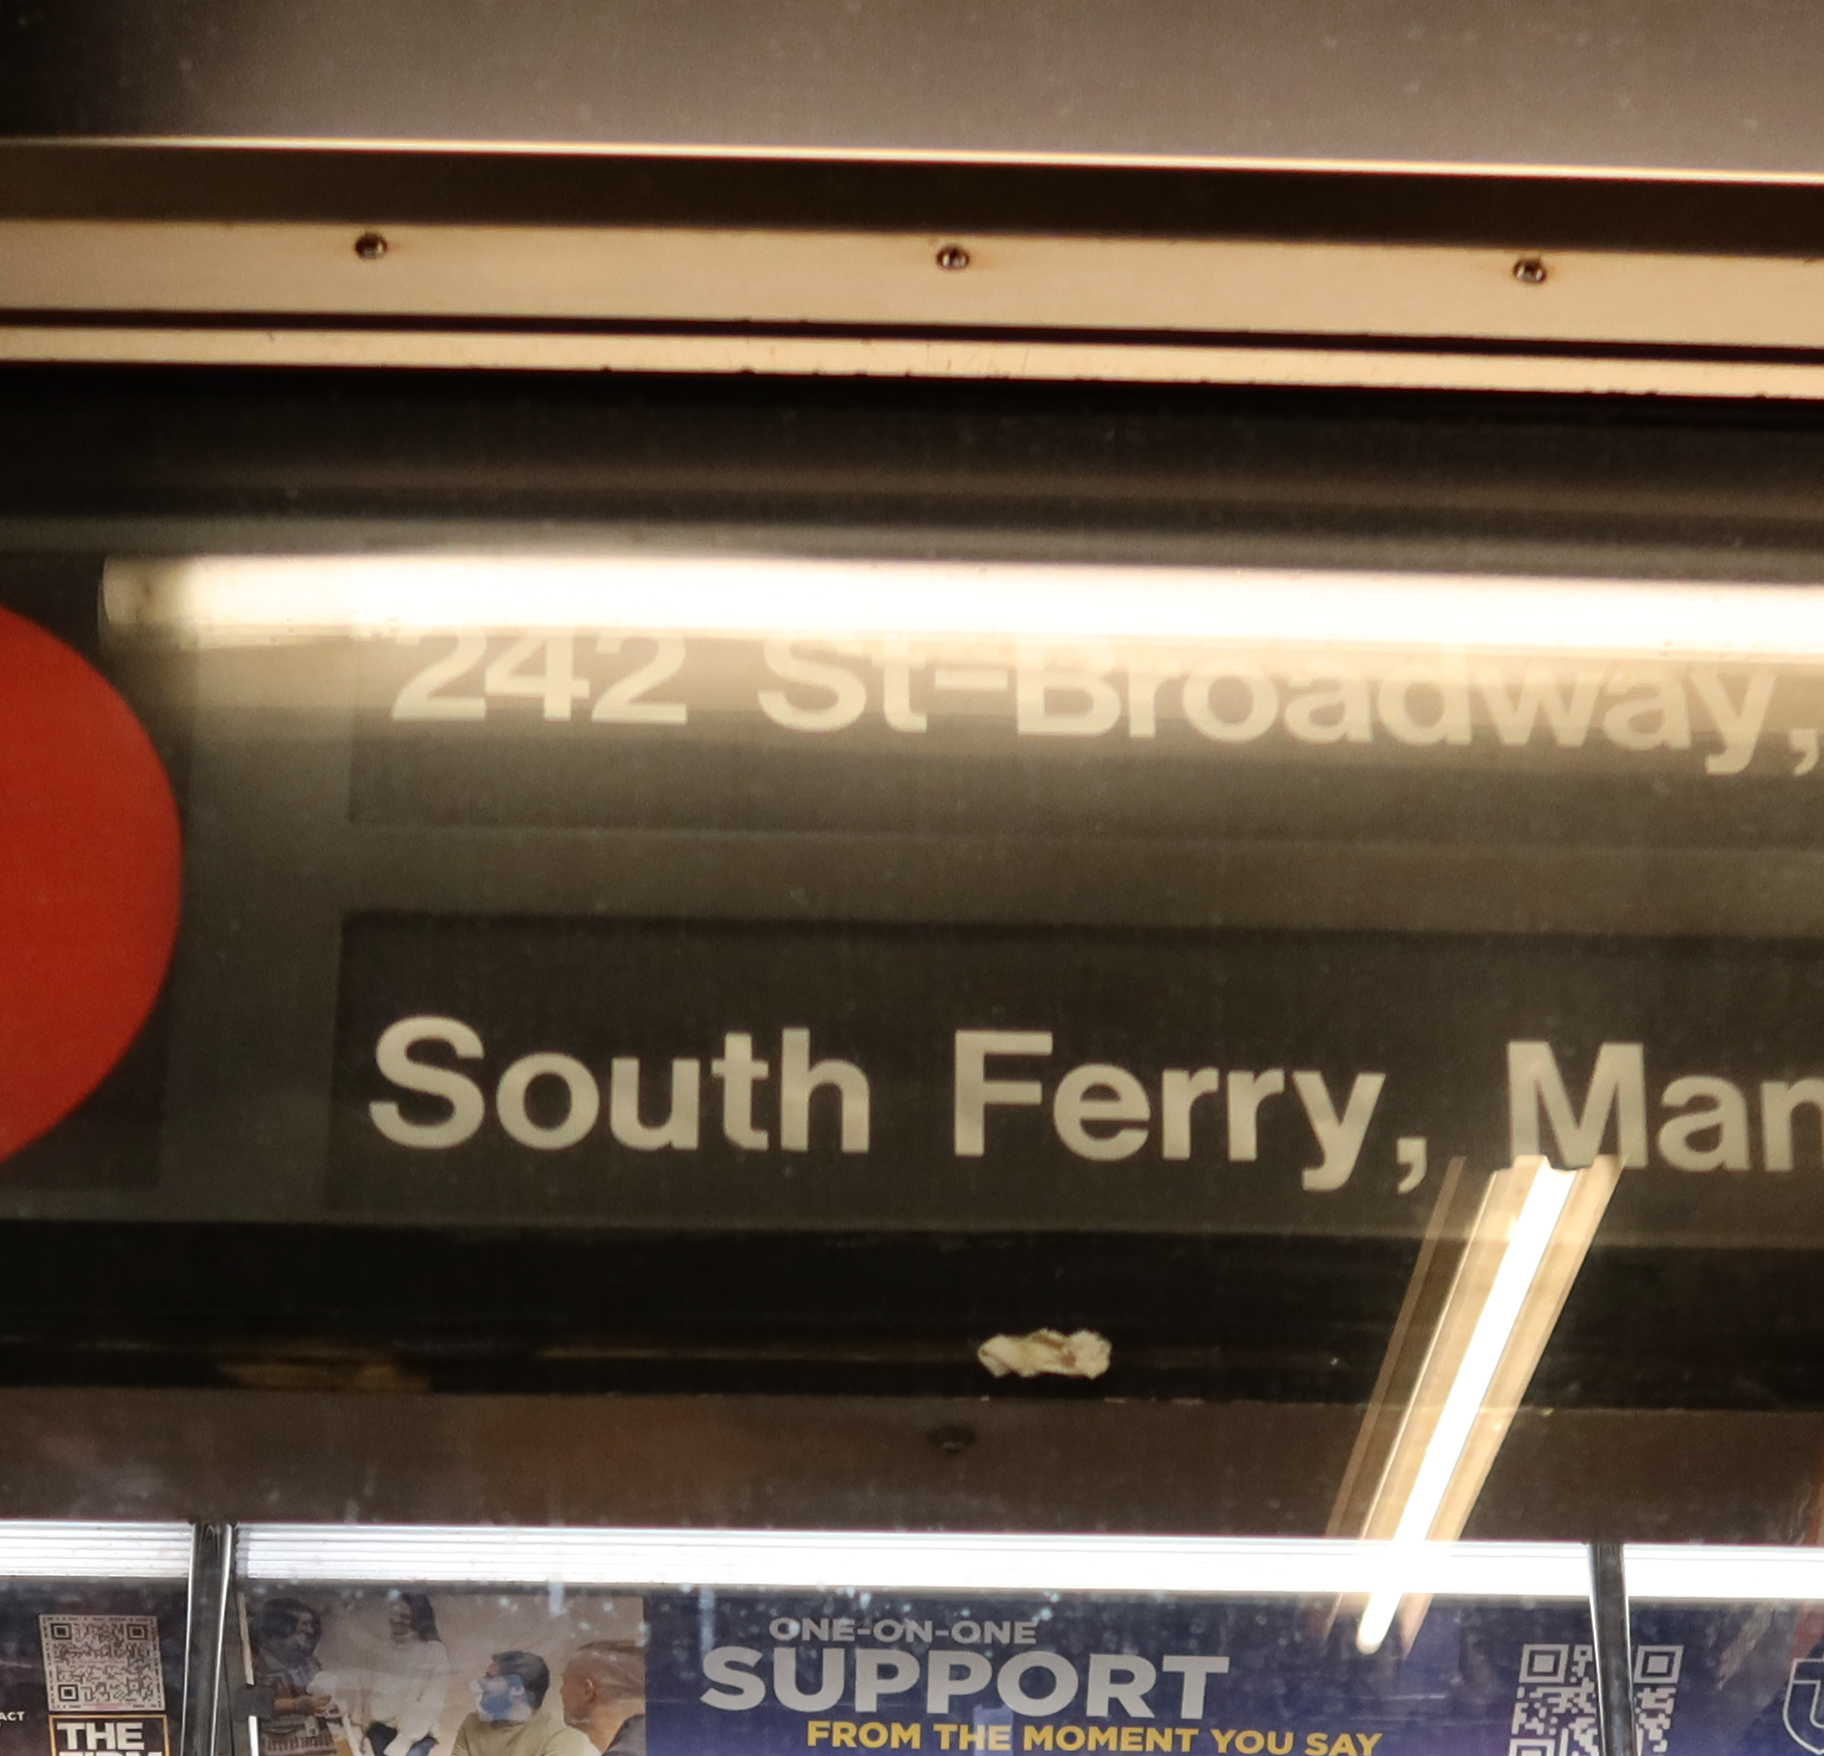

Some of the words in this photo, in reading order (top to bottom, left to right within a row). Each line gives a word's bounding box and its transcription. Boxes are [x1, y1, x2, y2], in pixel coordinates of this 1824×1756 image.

[391, 624, 688, 726] 242
[369, 1013, 871, 1153] South
[953, 1028, 1428, 1193] Ferry,
[769, 1616, 1037, 1646] ONE-ON-ONE
[700, 1646, 1230, 1720] SUPPORT
[56, 1722, 145, 1750] THE
[806, 1720, 922, 1750] FROM
[933, 1723, 1012, 1751] THE
[1022, 1725, 1198, 1753] MOMENT
[1212, 1728, 1294, 1756] YOU
[1303, 1731, 1383, 1756] SAY
